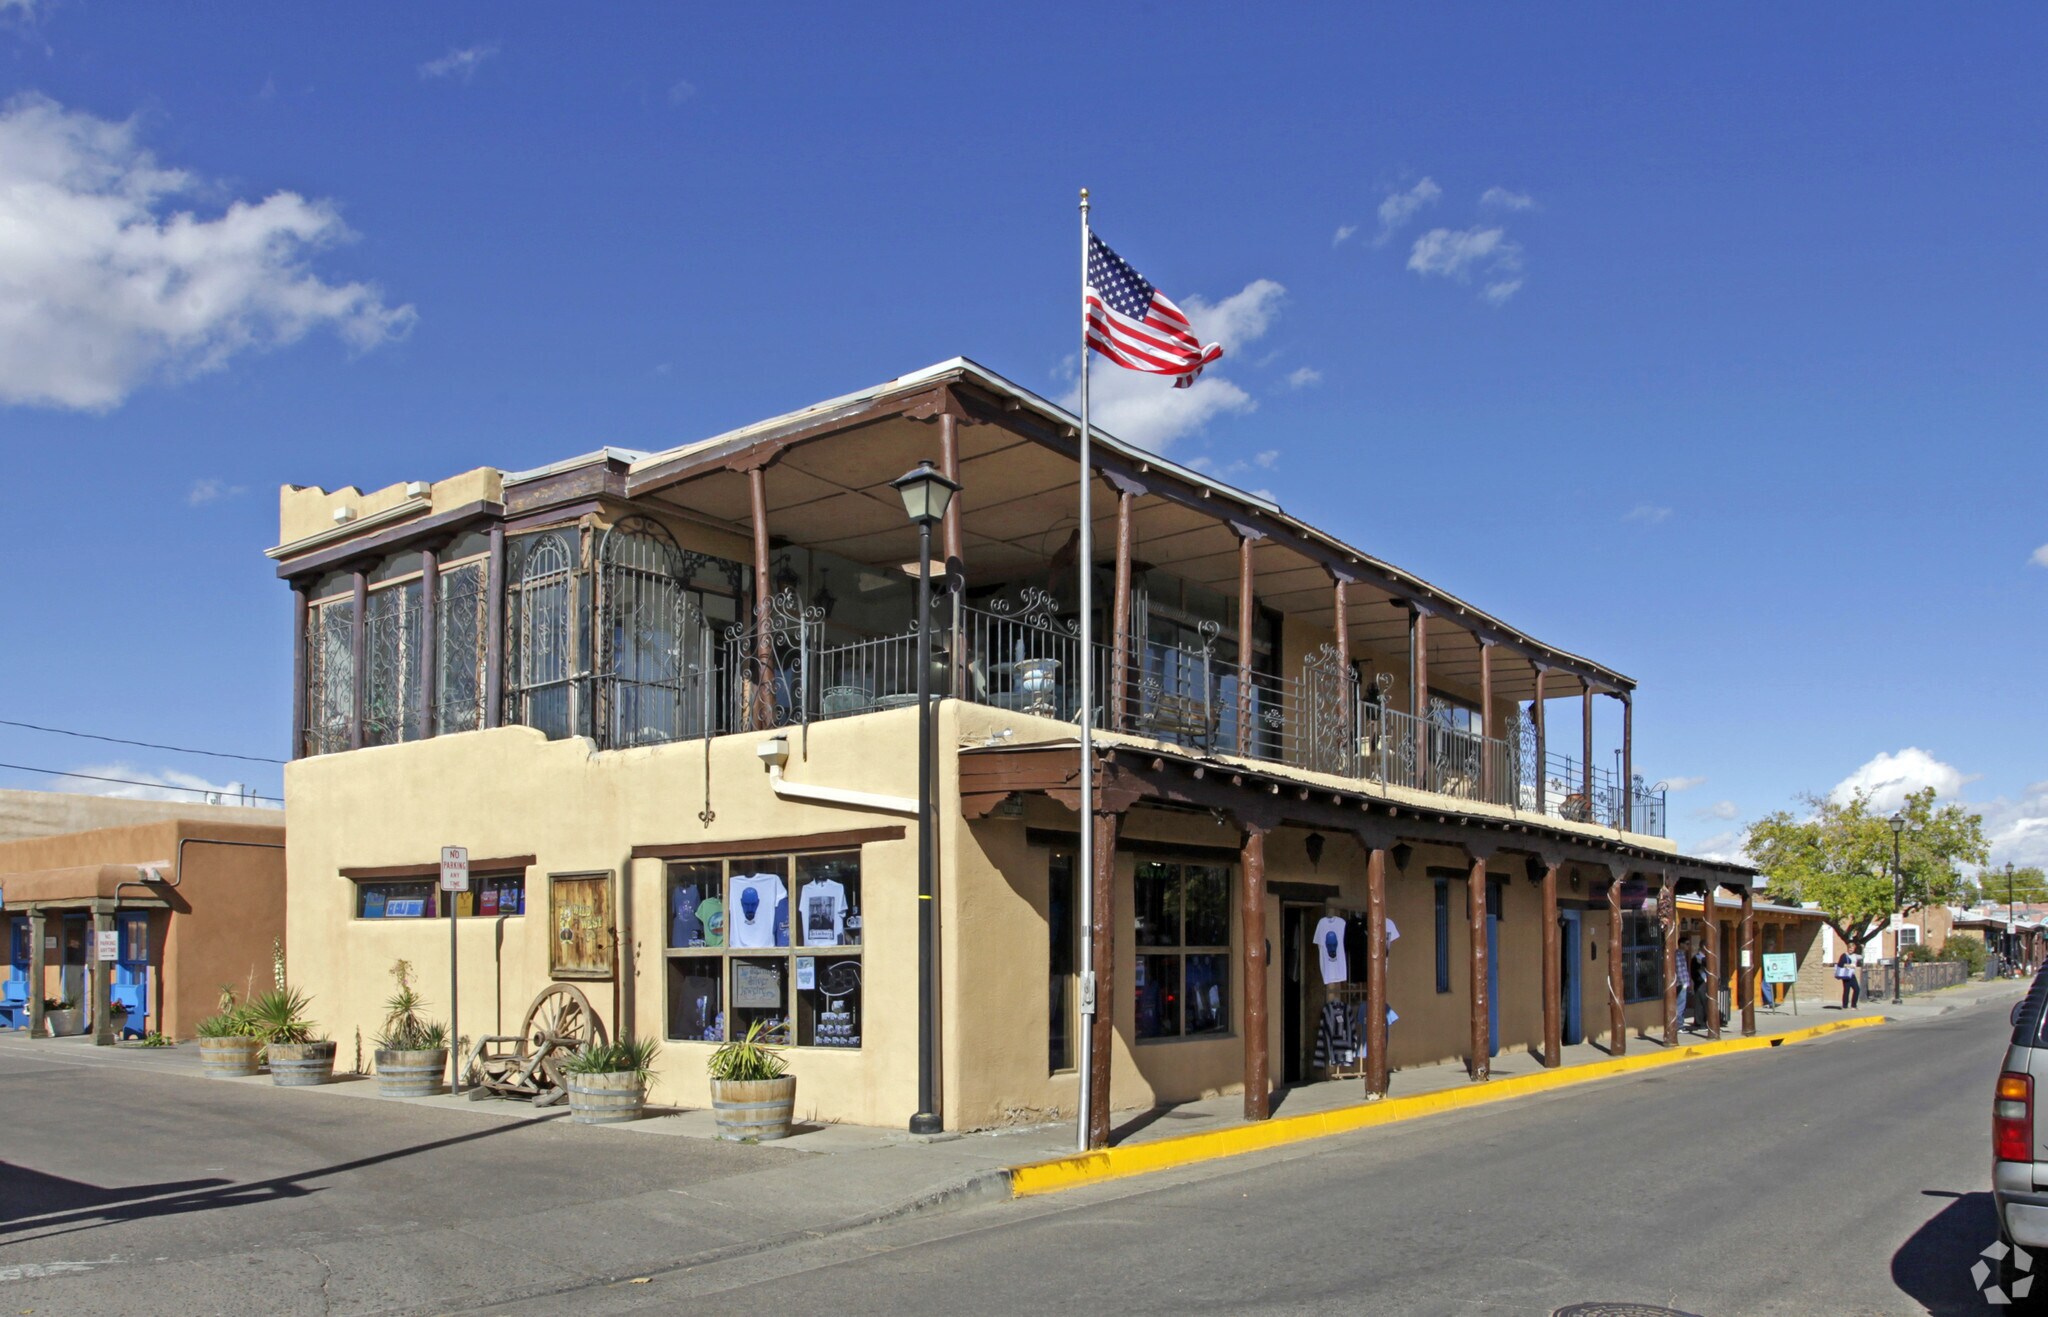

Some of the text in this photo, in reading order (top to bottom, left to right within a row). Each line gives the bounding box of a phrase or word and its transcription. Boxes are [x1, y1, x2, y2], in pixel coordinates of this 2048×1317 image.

[450, 850, 460, 858] NO
[444, 862, 466, 870] PARKING
[573, 905, 591, 916] WILD
[581, 916, 602, 929] WEST
